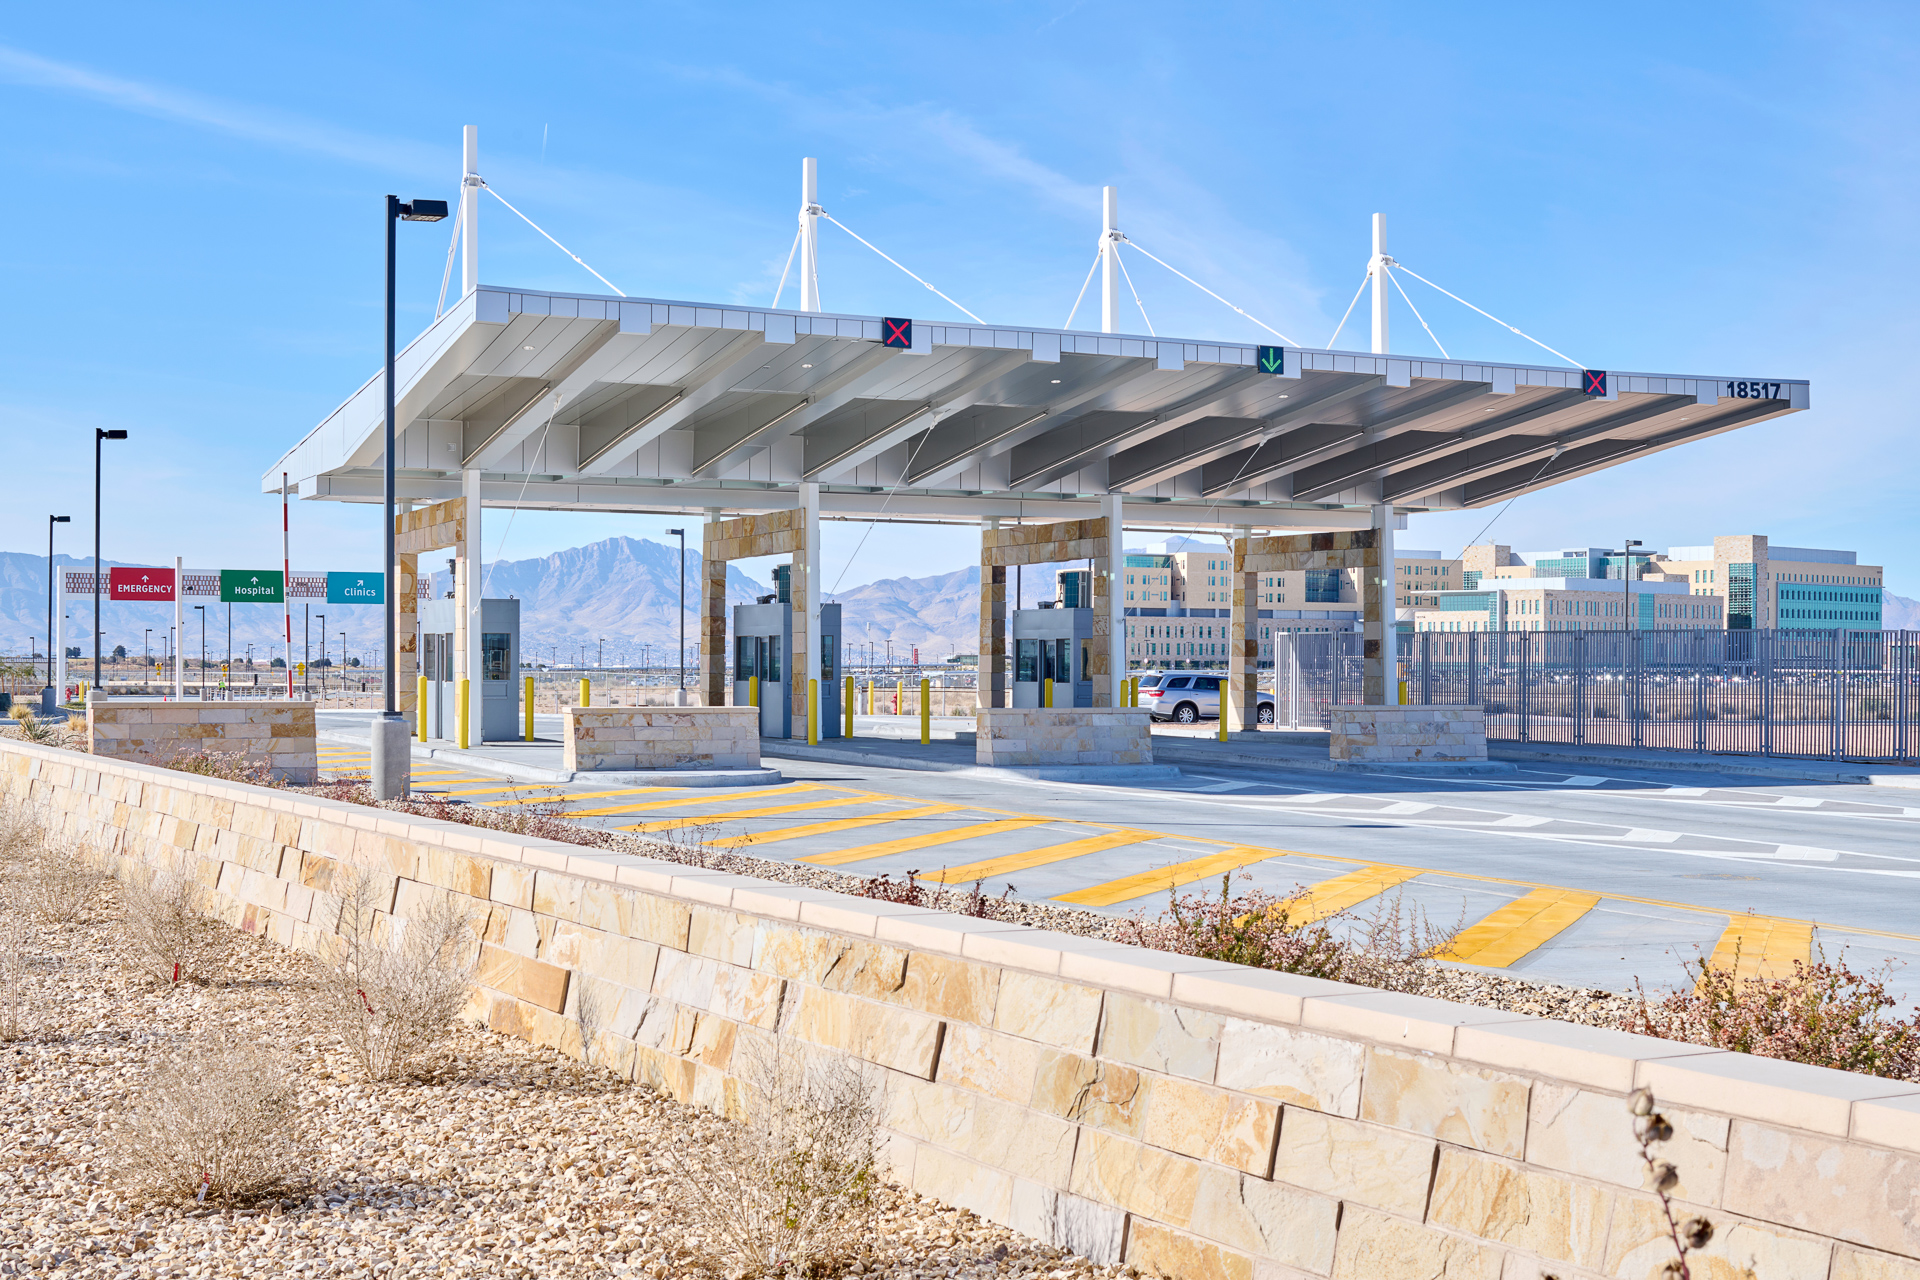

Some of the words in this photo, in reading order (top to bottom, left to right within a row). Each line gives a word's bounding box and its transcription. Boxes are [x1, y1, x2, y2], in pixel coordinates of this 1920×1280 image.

[1727, 381, 1780, 400] 18517
[117, 584, 172, 593] EMERGENCY
[234, 586, 274, 597] Hospital
[344, 587, 376, 597] Clinics
